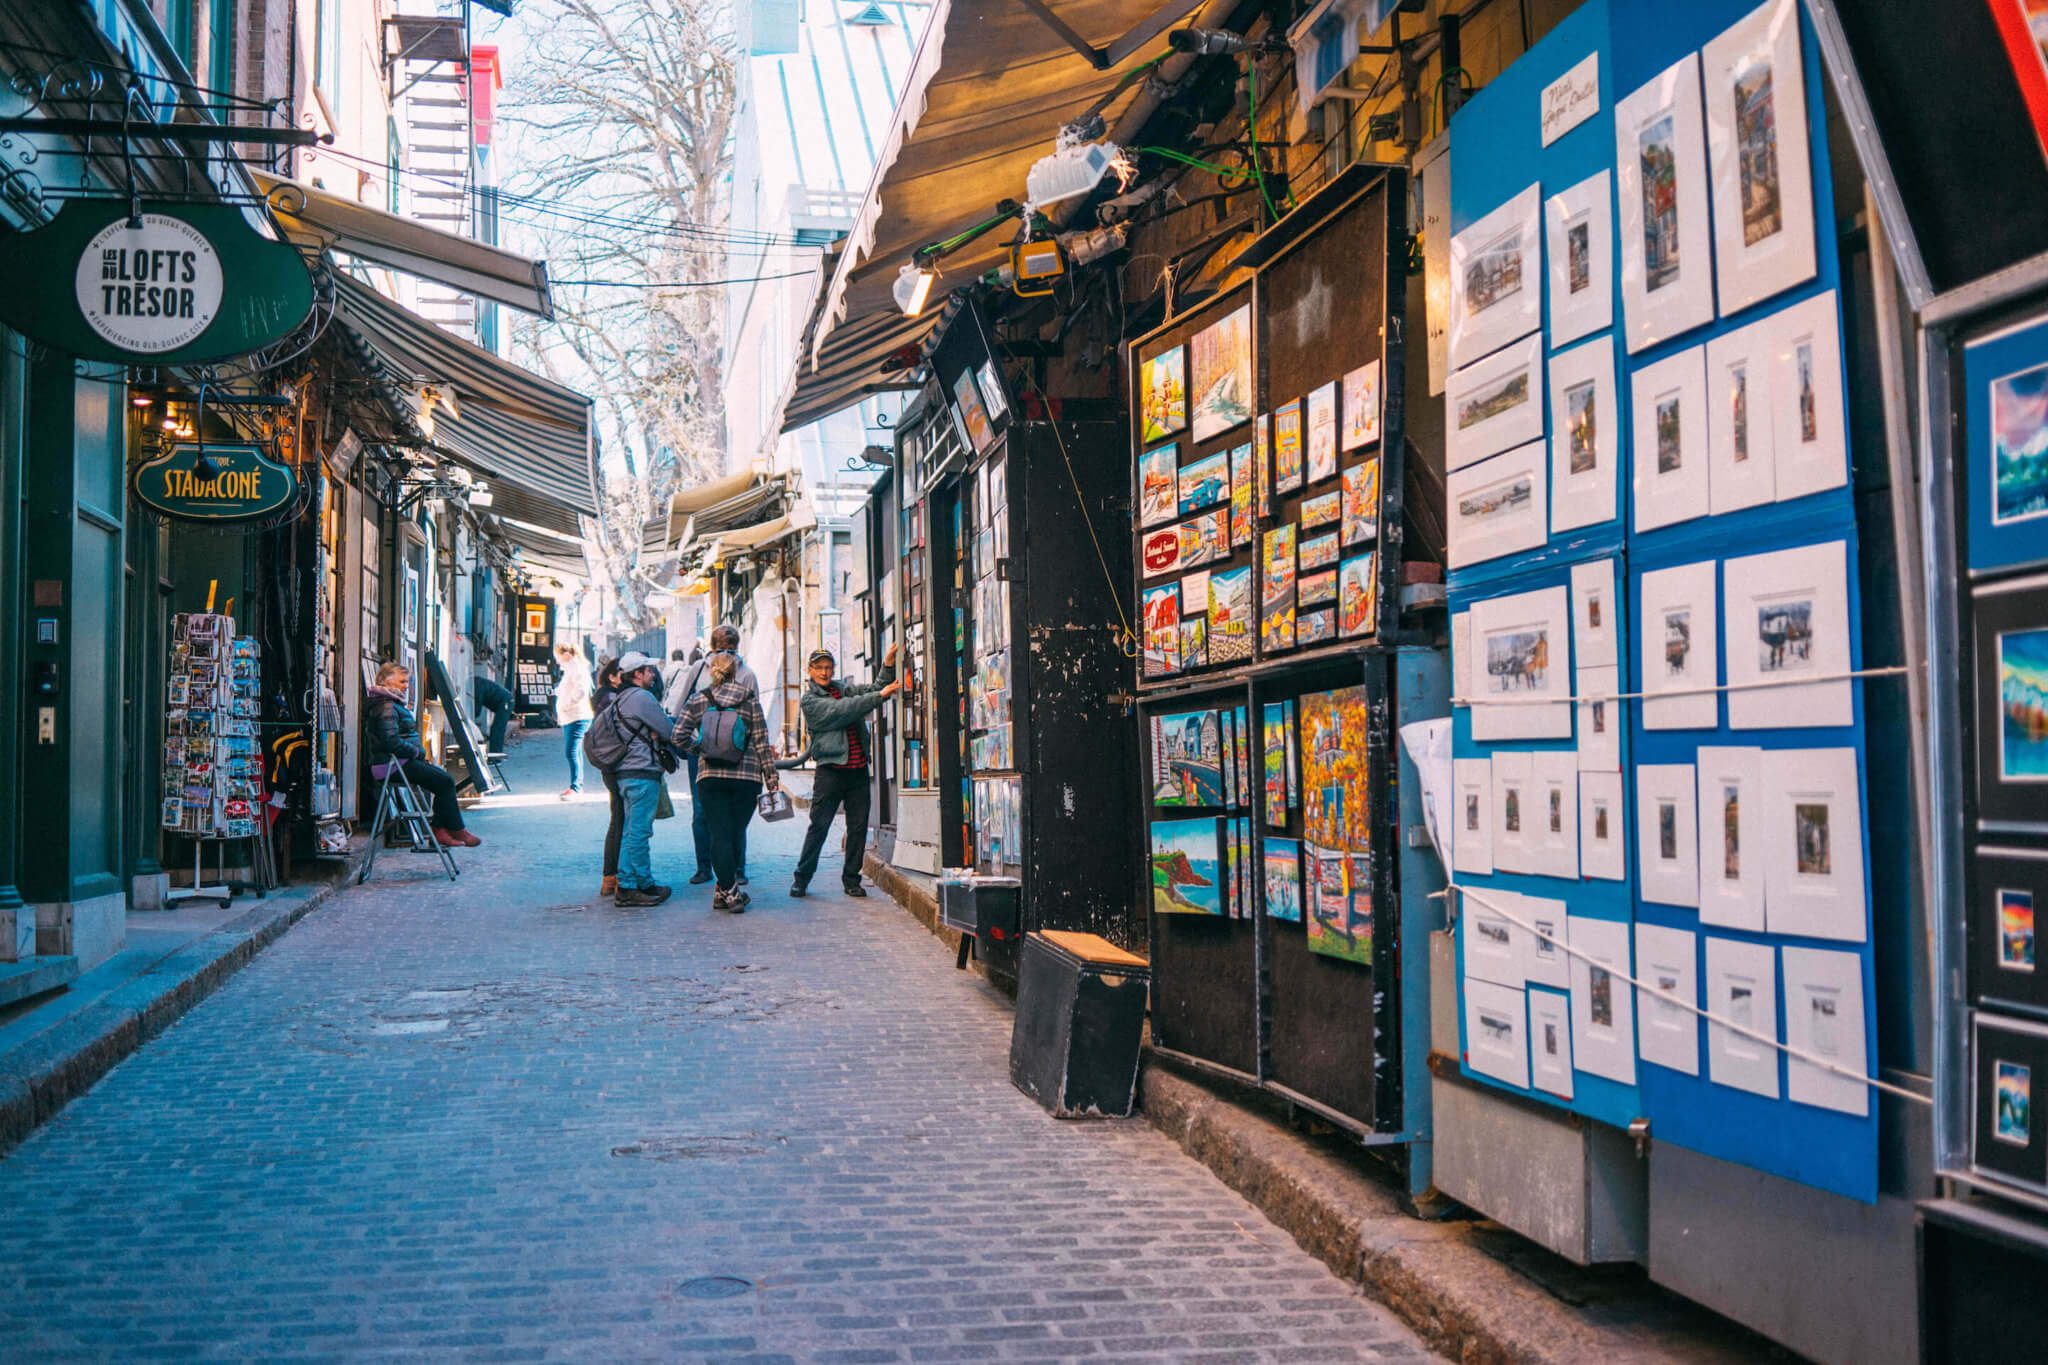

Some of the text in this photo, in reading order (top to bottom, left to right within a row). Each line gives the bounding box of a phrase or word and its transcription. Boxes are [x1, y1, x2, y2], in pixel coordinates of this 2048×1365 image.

[102, 248, 196, 283] LES LOFTS
[102, 266, 117, 280] DU
